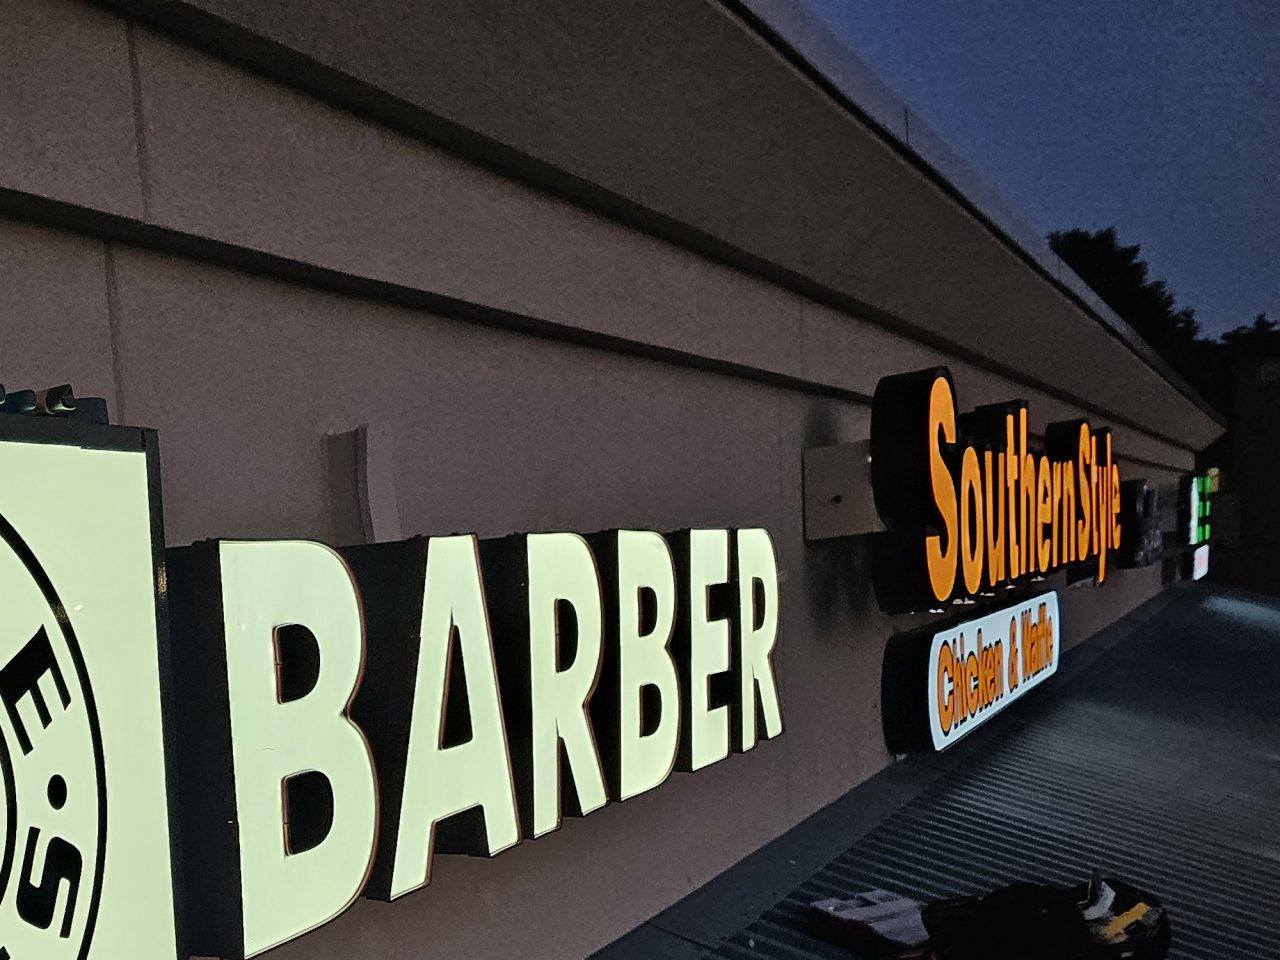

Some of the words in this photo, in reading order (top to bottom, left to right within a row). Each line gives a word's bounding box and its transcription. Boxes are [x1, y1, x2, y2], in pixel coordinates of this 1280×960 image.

[926, 376, 1076, 601] Southern
[1077, 422, 1121, 583] Style
[219, 527, 786, 960] BARBER
[937, 628, 1005, 737] Chicken
[1007, 615, 1019, 694] &
